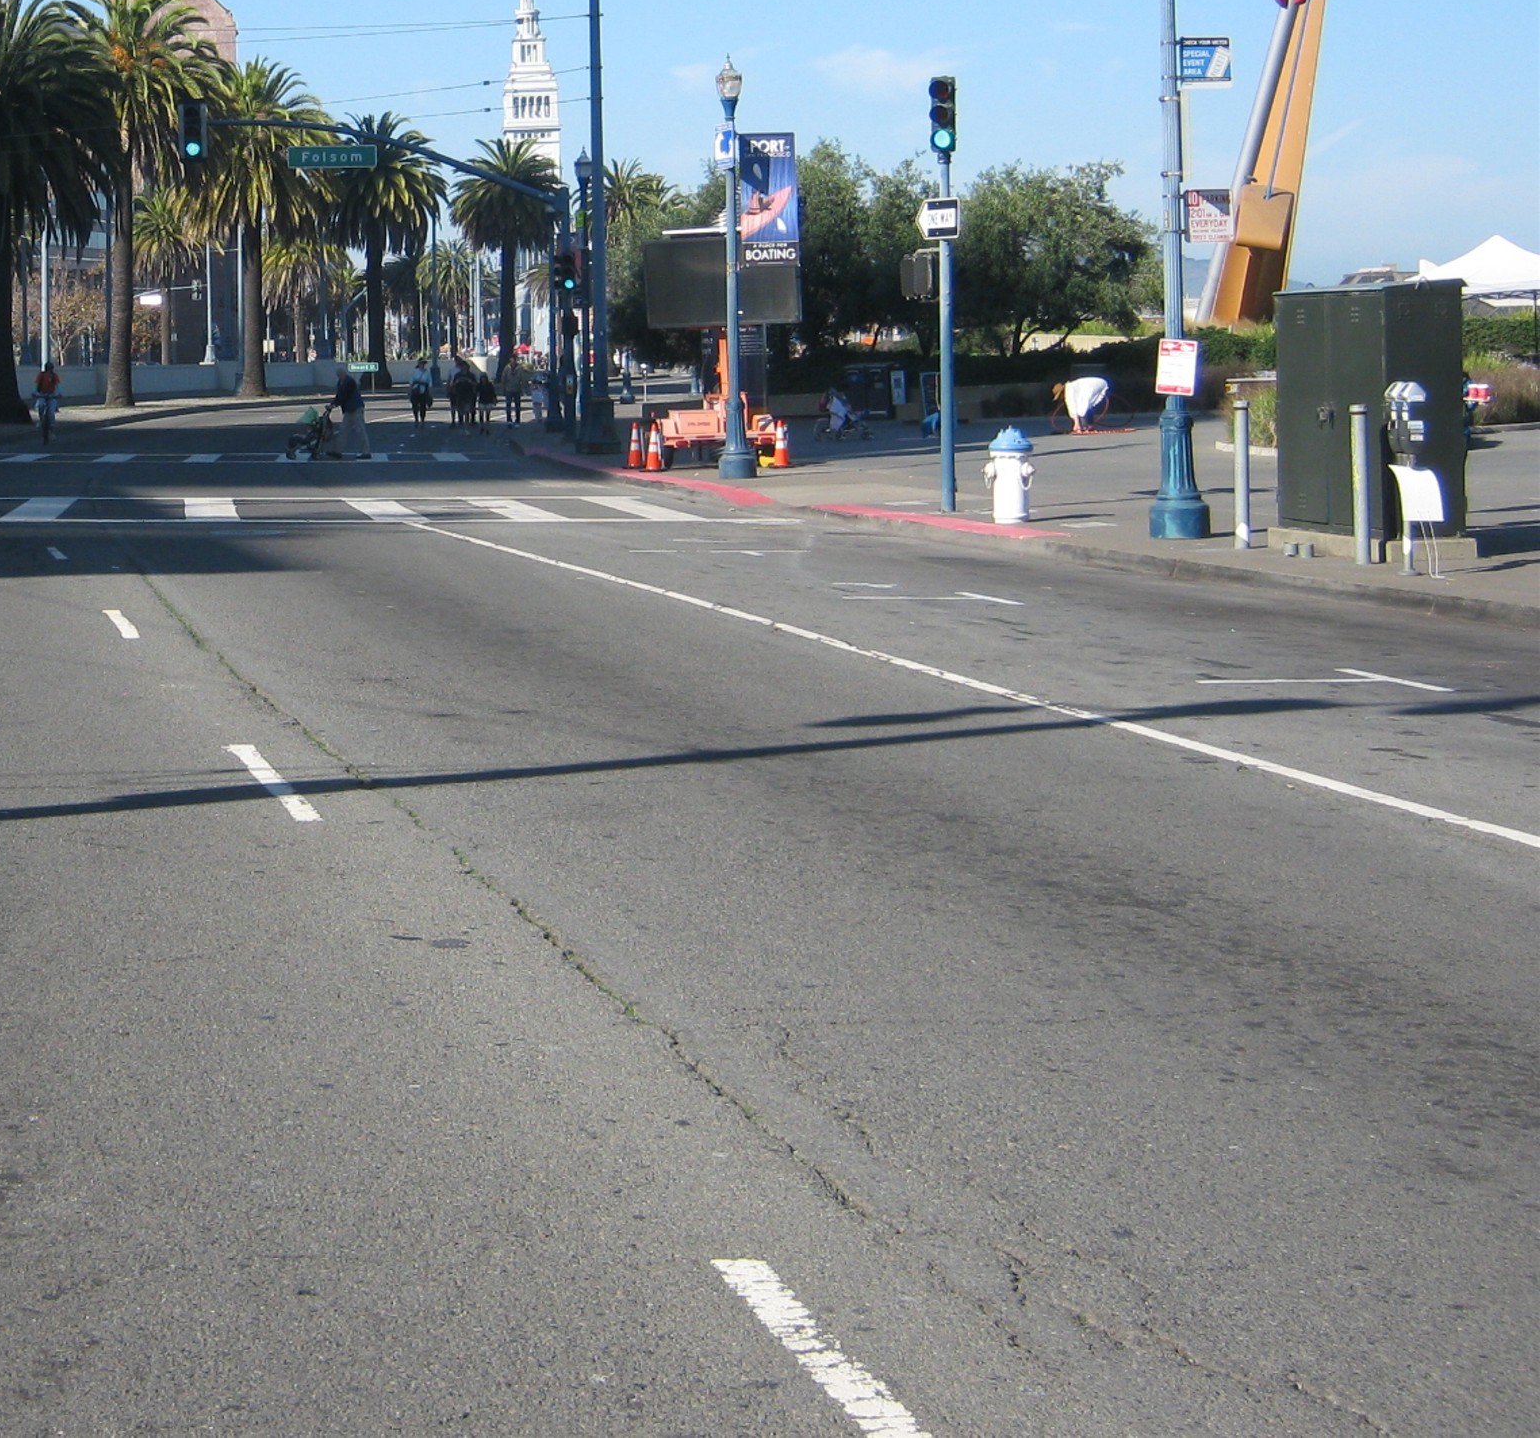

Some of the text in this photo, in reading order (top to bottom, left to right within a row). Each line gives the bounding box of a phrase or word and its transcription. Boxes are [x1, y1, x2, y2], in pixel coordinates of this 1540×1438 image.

[1182, 49, 1210, 58] SPECIAL
[1183, 59, 1204, 67] EVENT
[1183, 67, 1203, 75] AREA
[749, 139, 786, 153] PORT
[301, 151, 362, 163] Folsom
[928, 211, 953, 226] ONE WAY
[1191, 219, 1228, 228] EVERYDAY
[745, 248, 796, 262] BOATING
